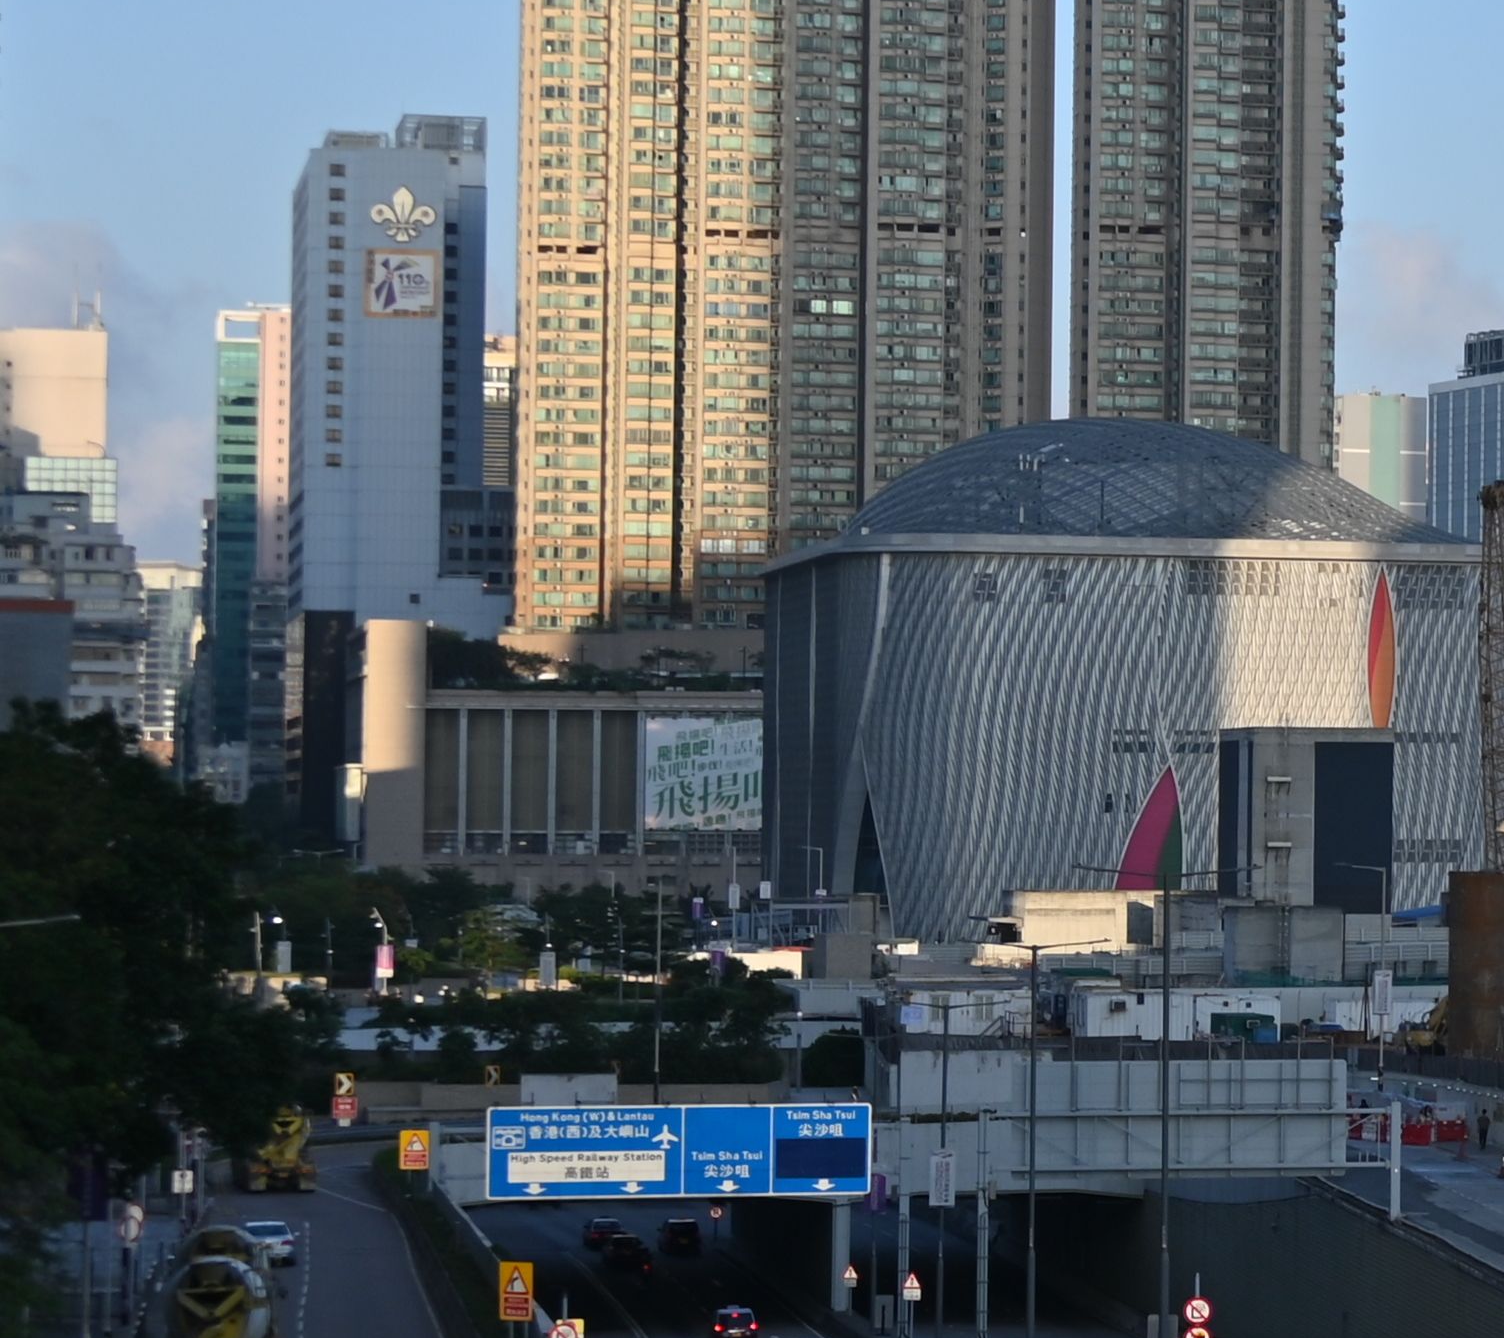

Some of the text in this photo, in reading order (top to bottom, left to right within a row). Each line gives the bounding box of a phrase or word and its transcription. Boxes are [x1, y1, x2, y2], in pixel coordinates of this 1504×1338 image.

[520, 1112, 549, 1123] Hong
[552, 1112, 580, 1123] Kong
[786, 1110, 856, 1121] Tsim Sha Tsui
[798, 1123, 844, 1137] 尖沙咀
[510, 1152, 662, 1164] High Speed Railway Station
[691, 1151, 763, 1161] Tsim Sha Tsui
[704, 1164, 750, 1178] 尖沙咀
